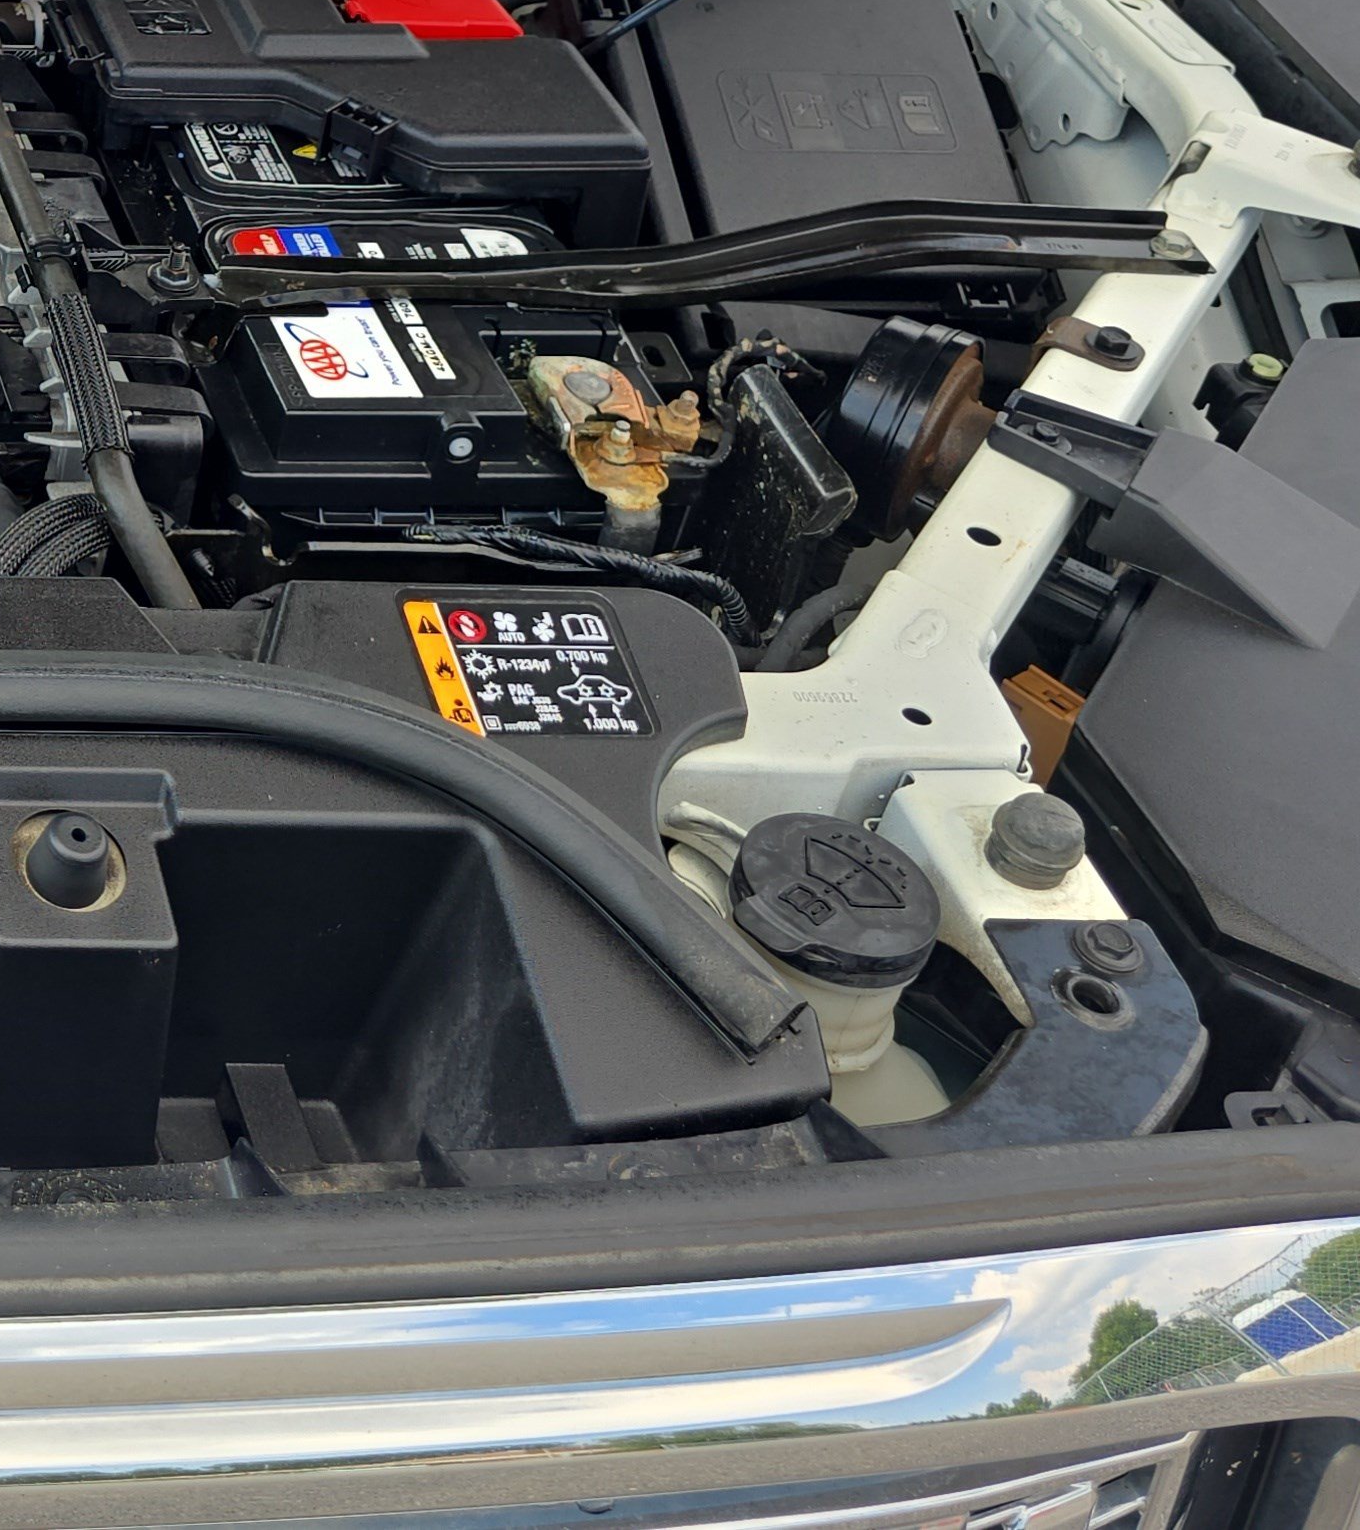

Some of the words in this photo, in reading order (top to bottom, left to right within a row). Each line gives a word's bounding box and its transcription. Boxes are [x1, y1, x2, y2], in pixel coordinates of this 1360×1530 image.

[368, 336, 381, 349] can
[301, 341, 346, 379] AAA
[498, 632, 526, 644] AUTO
[590, 651, 608, 665] kg
[496, 658, 551, 673] R-1234yf
[507, 683, 535, 696] PAG
[583, 717, 619, 731] 1.000
[619, 719, 638, 733] kg
